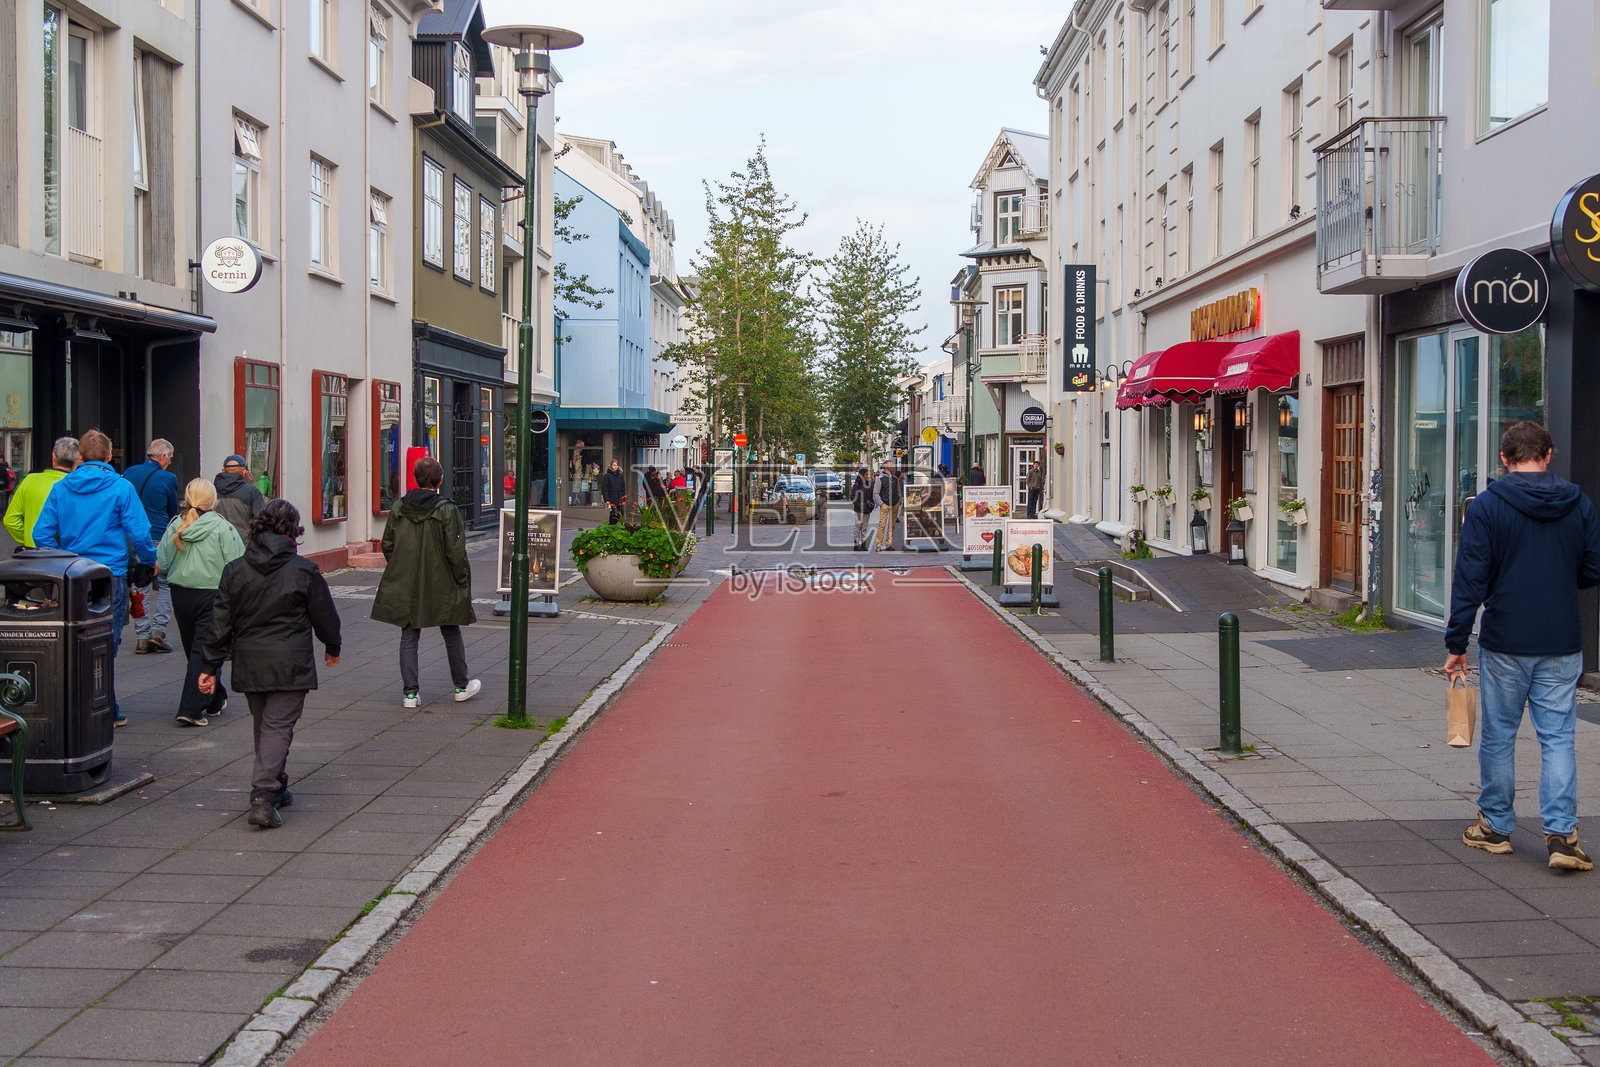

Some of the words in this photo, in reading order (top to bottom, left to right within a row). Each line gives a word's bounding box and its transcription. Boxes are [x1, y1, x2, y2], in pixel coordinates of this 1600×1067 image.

[211, 270, 247, 279] Cernin
[1076, 270, 1086, 304] DRINKS
[1076, 305, 1086, 313] &
[1076, 312, 1086, 340] FOOD
[1072, 374, 1088, 386] Gull
[634, 436, 658, 444] kokka
